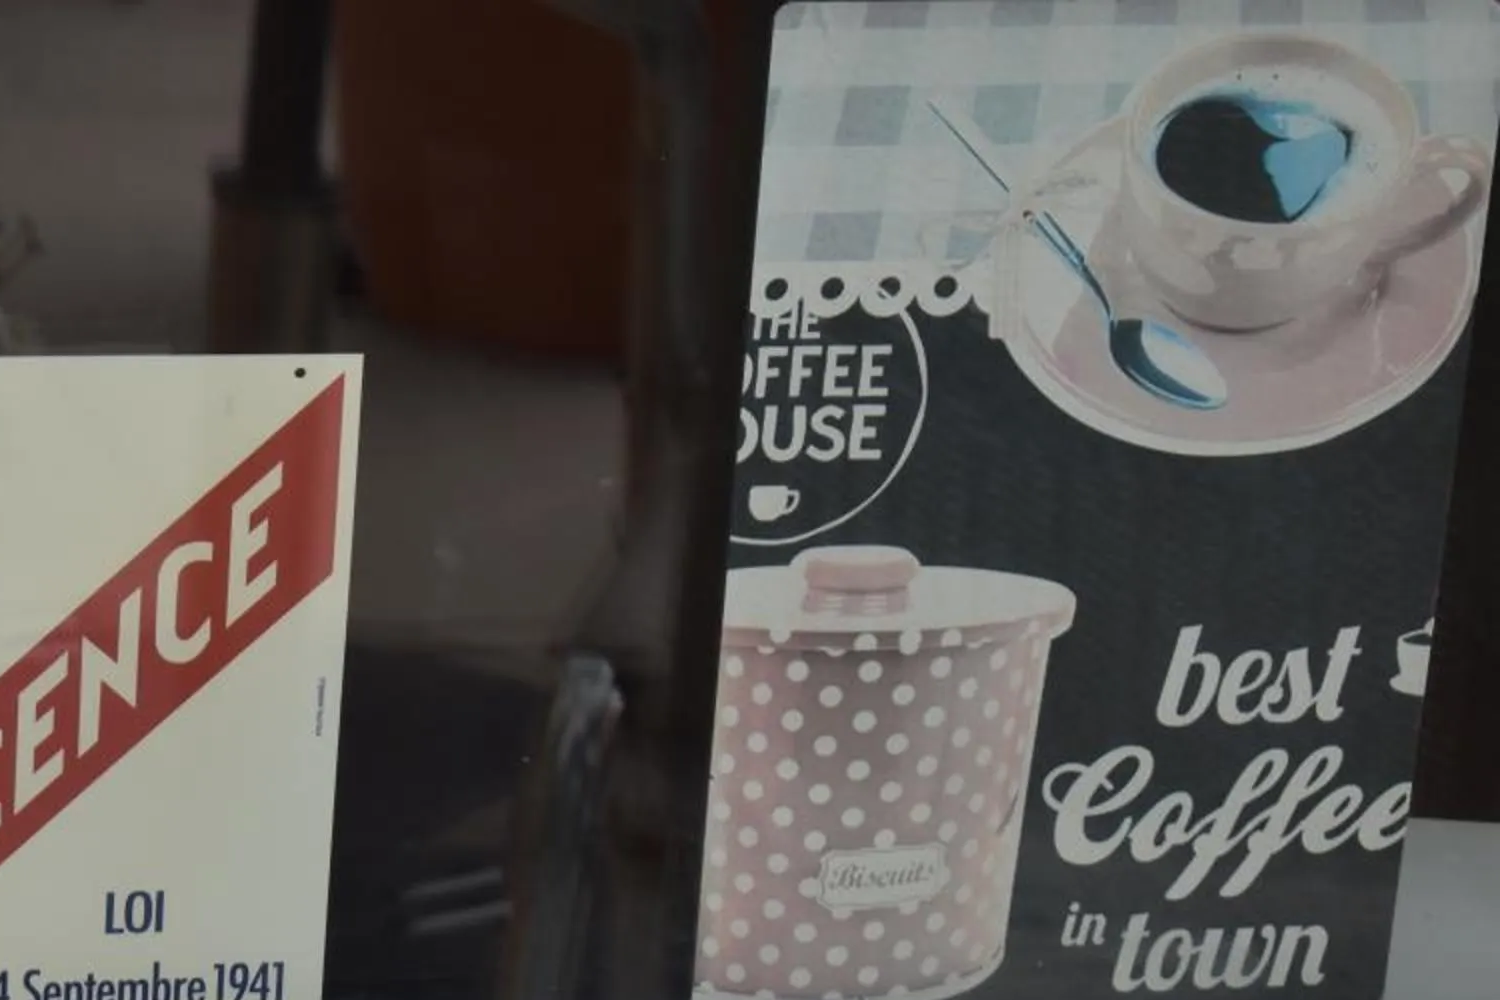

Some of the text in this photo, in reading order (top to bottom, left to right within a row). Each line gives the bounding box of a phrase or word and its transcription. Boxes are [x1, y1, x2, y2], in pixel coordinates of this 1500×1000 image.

[752, 313, 821, 340] THE
[742, 344, 893, 399] FFEE
[1155, 625, 1361, 728] best
[1042, 745, 1412, 900] Coffee
[104, 890, 165, 935] LOI
[1061, 902, 1329, 993] in town
